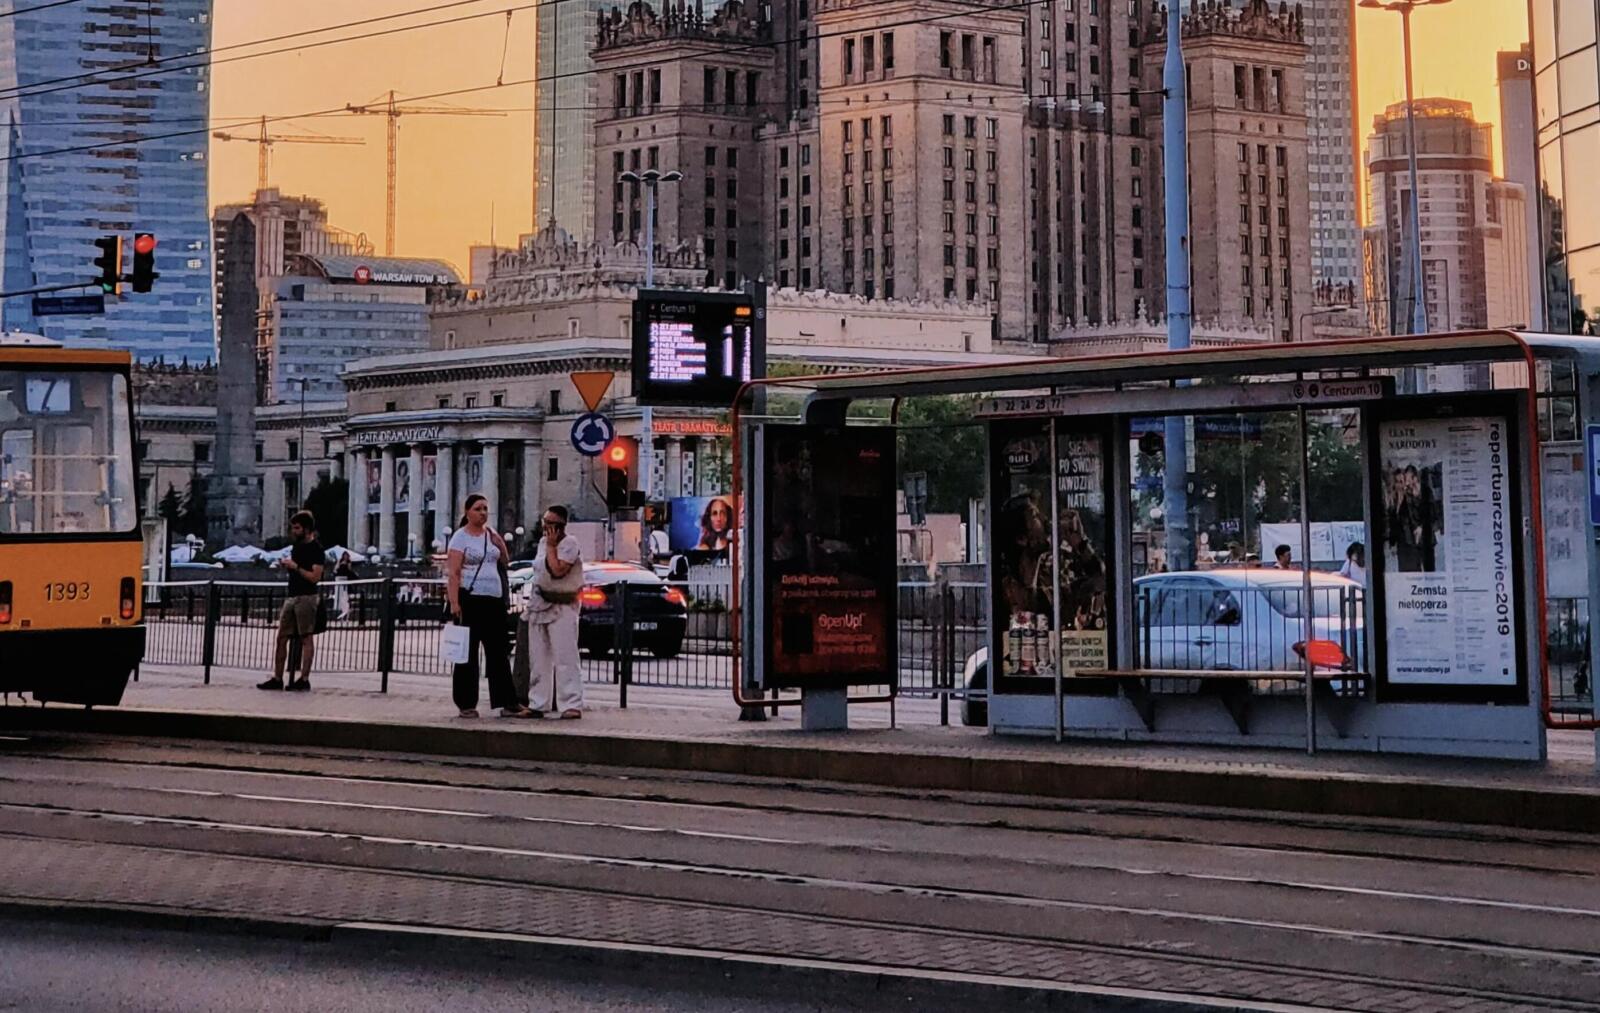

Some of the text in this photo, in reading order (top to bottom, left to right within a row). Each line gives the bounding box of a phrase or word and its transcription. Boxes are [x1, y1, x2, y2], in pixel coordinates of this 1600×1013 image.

[373, 272, 448, 284] WARSAW TOWRS
[660, 303, 687, 313] Centrum
[1323, 383, 1380, 397] Centrum 10
[1006, 400, 1016, 411] 22
[653, 422, 676, 433] TEATR
[379, 427, 440, 442] DRAMATYCZNY
[44, 582, 90, 601] 1393
[1411, 585, 1447, 595] Zemsta
[1398, 599, 1448, 611] nietoperza
